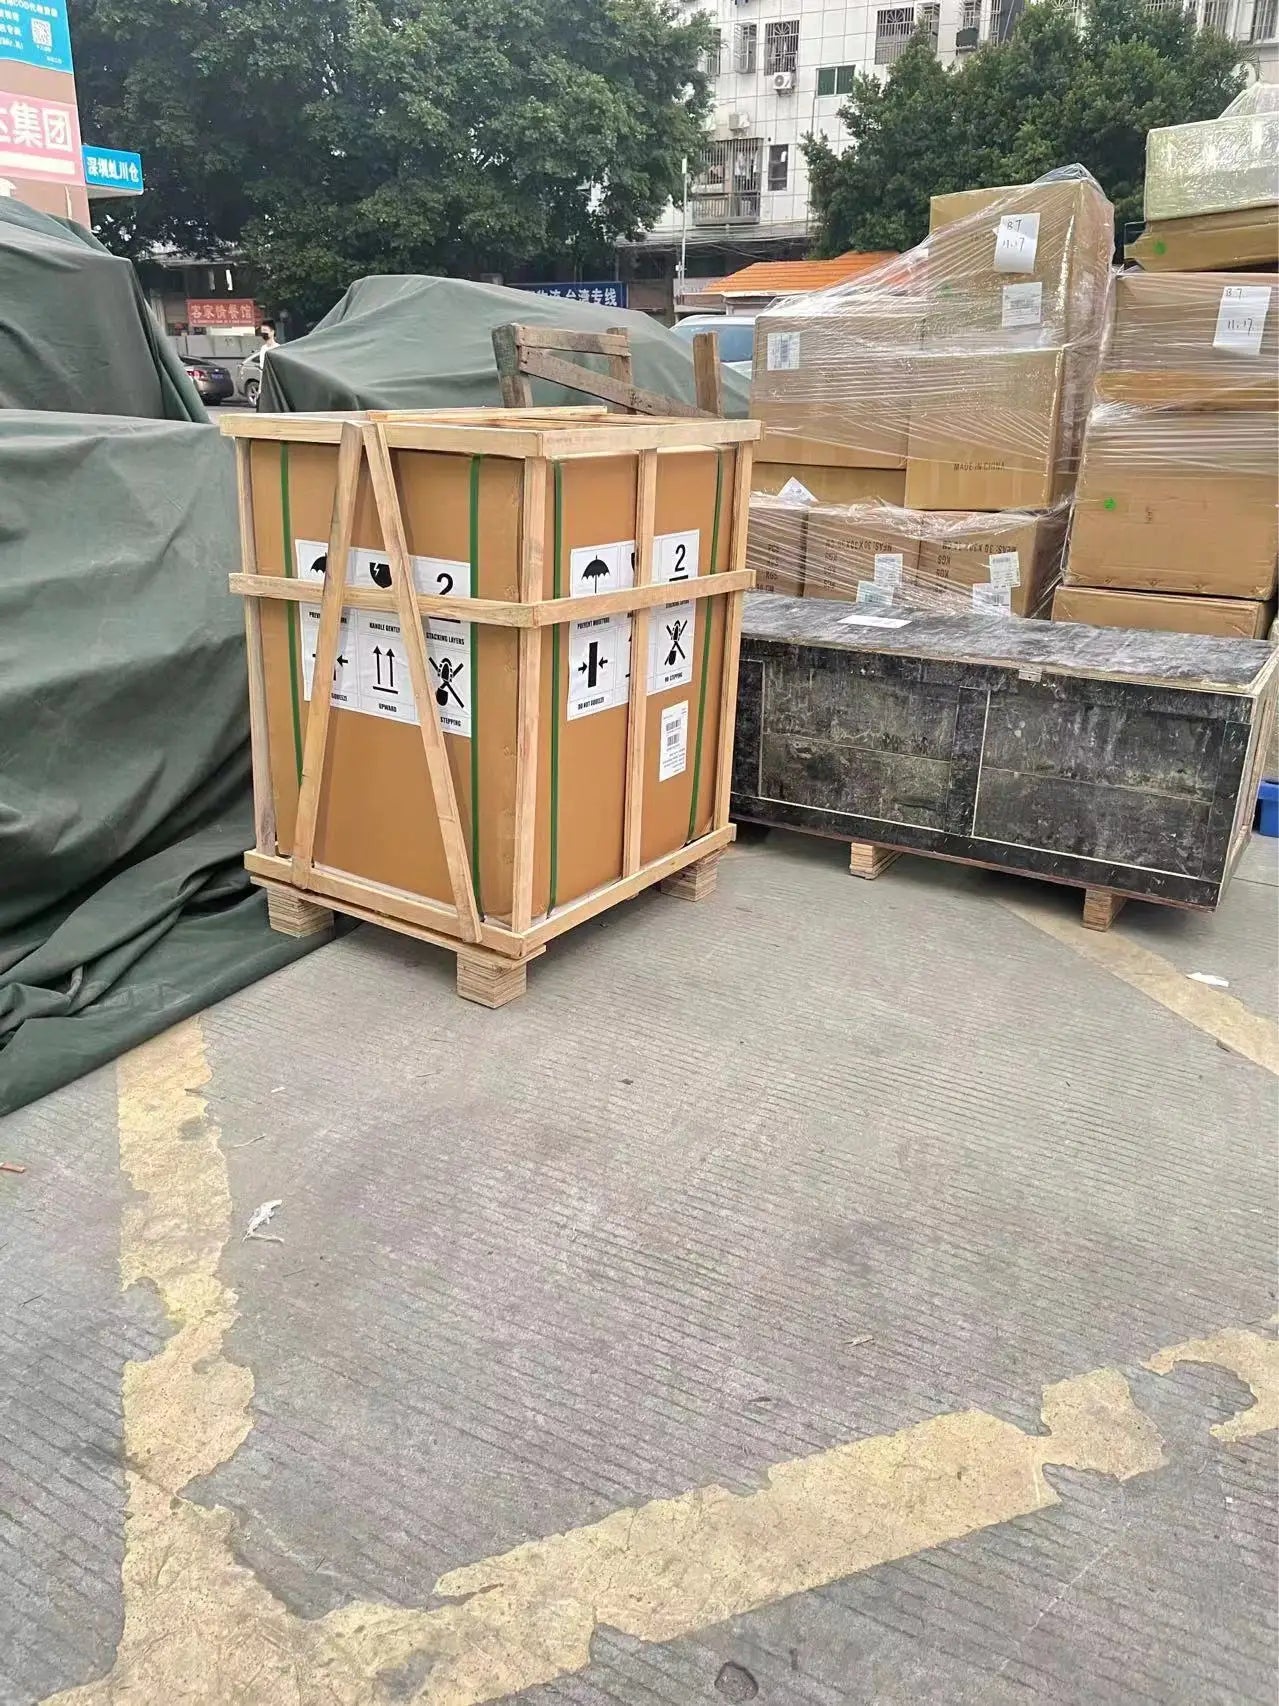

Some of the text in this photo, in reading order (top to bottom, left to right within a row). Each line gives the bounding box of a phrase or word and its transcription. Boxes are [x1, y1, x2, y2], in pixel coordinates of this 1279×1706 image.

[674, 543, 686, 573] 2
[436, 572, 454, 595] 2
[308, 611, 321, 619] PREV
[369, 622, 385, 633] HANDLE
[425, 631, 465, 646] STACKING LAYERS
[378, 702, 397, 713] UPWARD
[577, 703, 583, 711] DO
[440, 715, 462, 728] STEPPING
